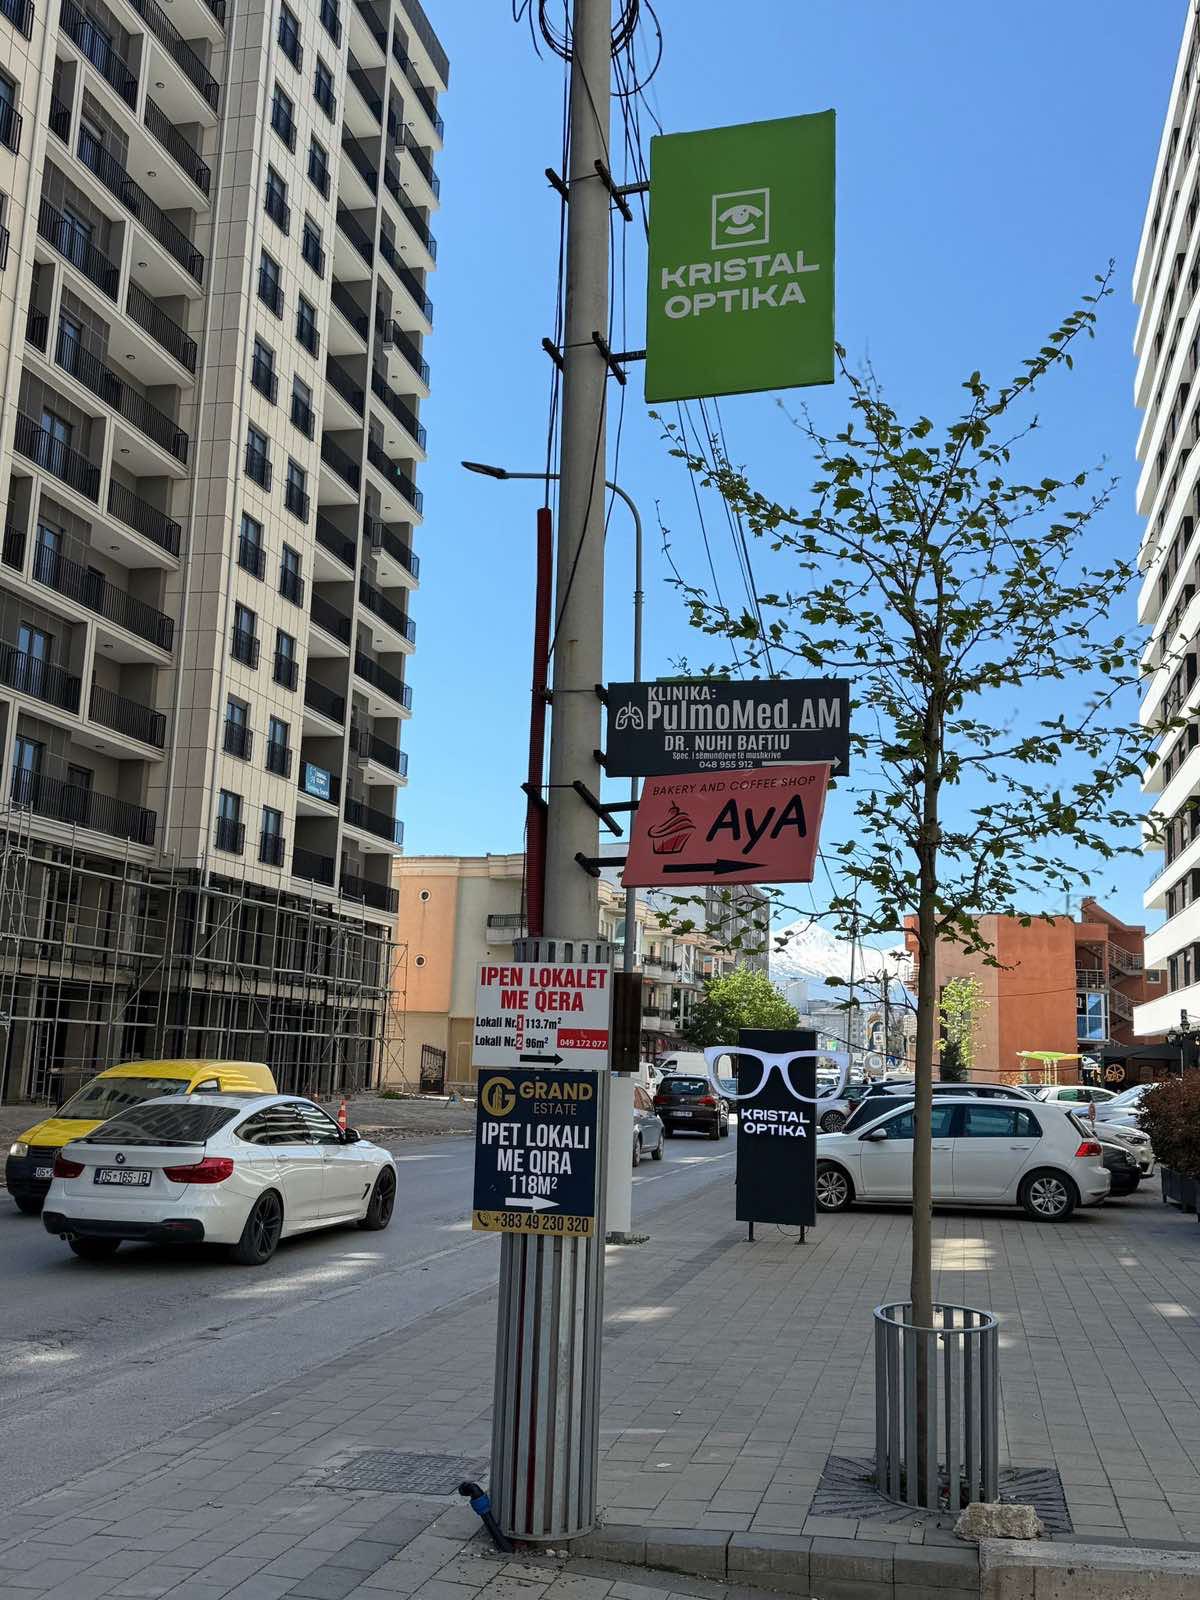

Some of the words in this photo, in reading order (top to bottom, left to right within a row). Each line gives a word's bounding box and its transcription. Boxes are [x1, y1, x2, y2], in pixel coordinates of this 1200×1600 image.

[661, 250, 820, 290] KRISTAL
[664, 282, 806, 320] OPTIKA
[647, 686, 717, 701] KLINIKA:
[647, 698, 841, 730] PulmoMed.AM
[664, 736, 689, 751] DR.
[695, 735, 732, 751] NUHI
[737, 734, 790, 750] BAFTIU
[653, 783, 696, 796] BAKERY
[699, 782, 725, 793] AND
[729, 778, 777, 791] COFFEE
[780, 775, 816, 787] SHOP
[706, 794, 807, 855] AyA
[481, 967, 523, 986] IPEN
[529, 967, 608, 989] LOKALET
[500, 990, 529, 1010] ME
[535, 991, 584, 1013] QERA
[560, 1039, 574, 1047] 049
[576, 1039, 590, 1047] 172
[519, 1081, 593, 1101] GRAND
[532, 1102, 577, 1116] ESTATE
[741, 1108, 810, 1123] KRISTAL
[481, 1122, 521, 1146] IPET
[526, 1124, 590, 1149] LOKALI
[744, 1122, 806, 1137] OPTIKA
[497, 1149, 525, 1172] ME
[529, 1151, 572, 1175] QIRA
[494, 1213, 522, 1228] +383
[525, 1215, 540, 1230] 49
[542, 1217, 564, 1231] 230
[567, 1217, 589, 1233] 320
